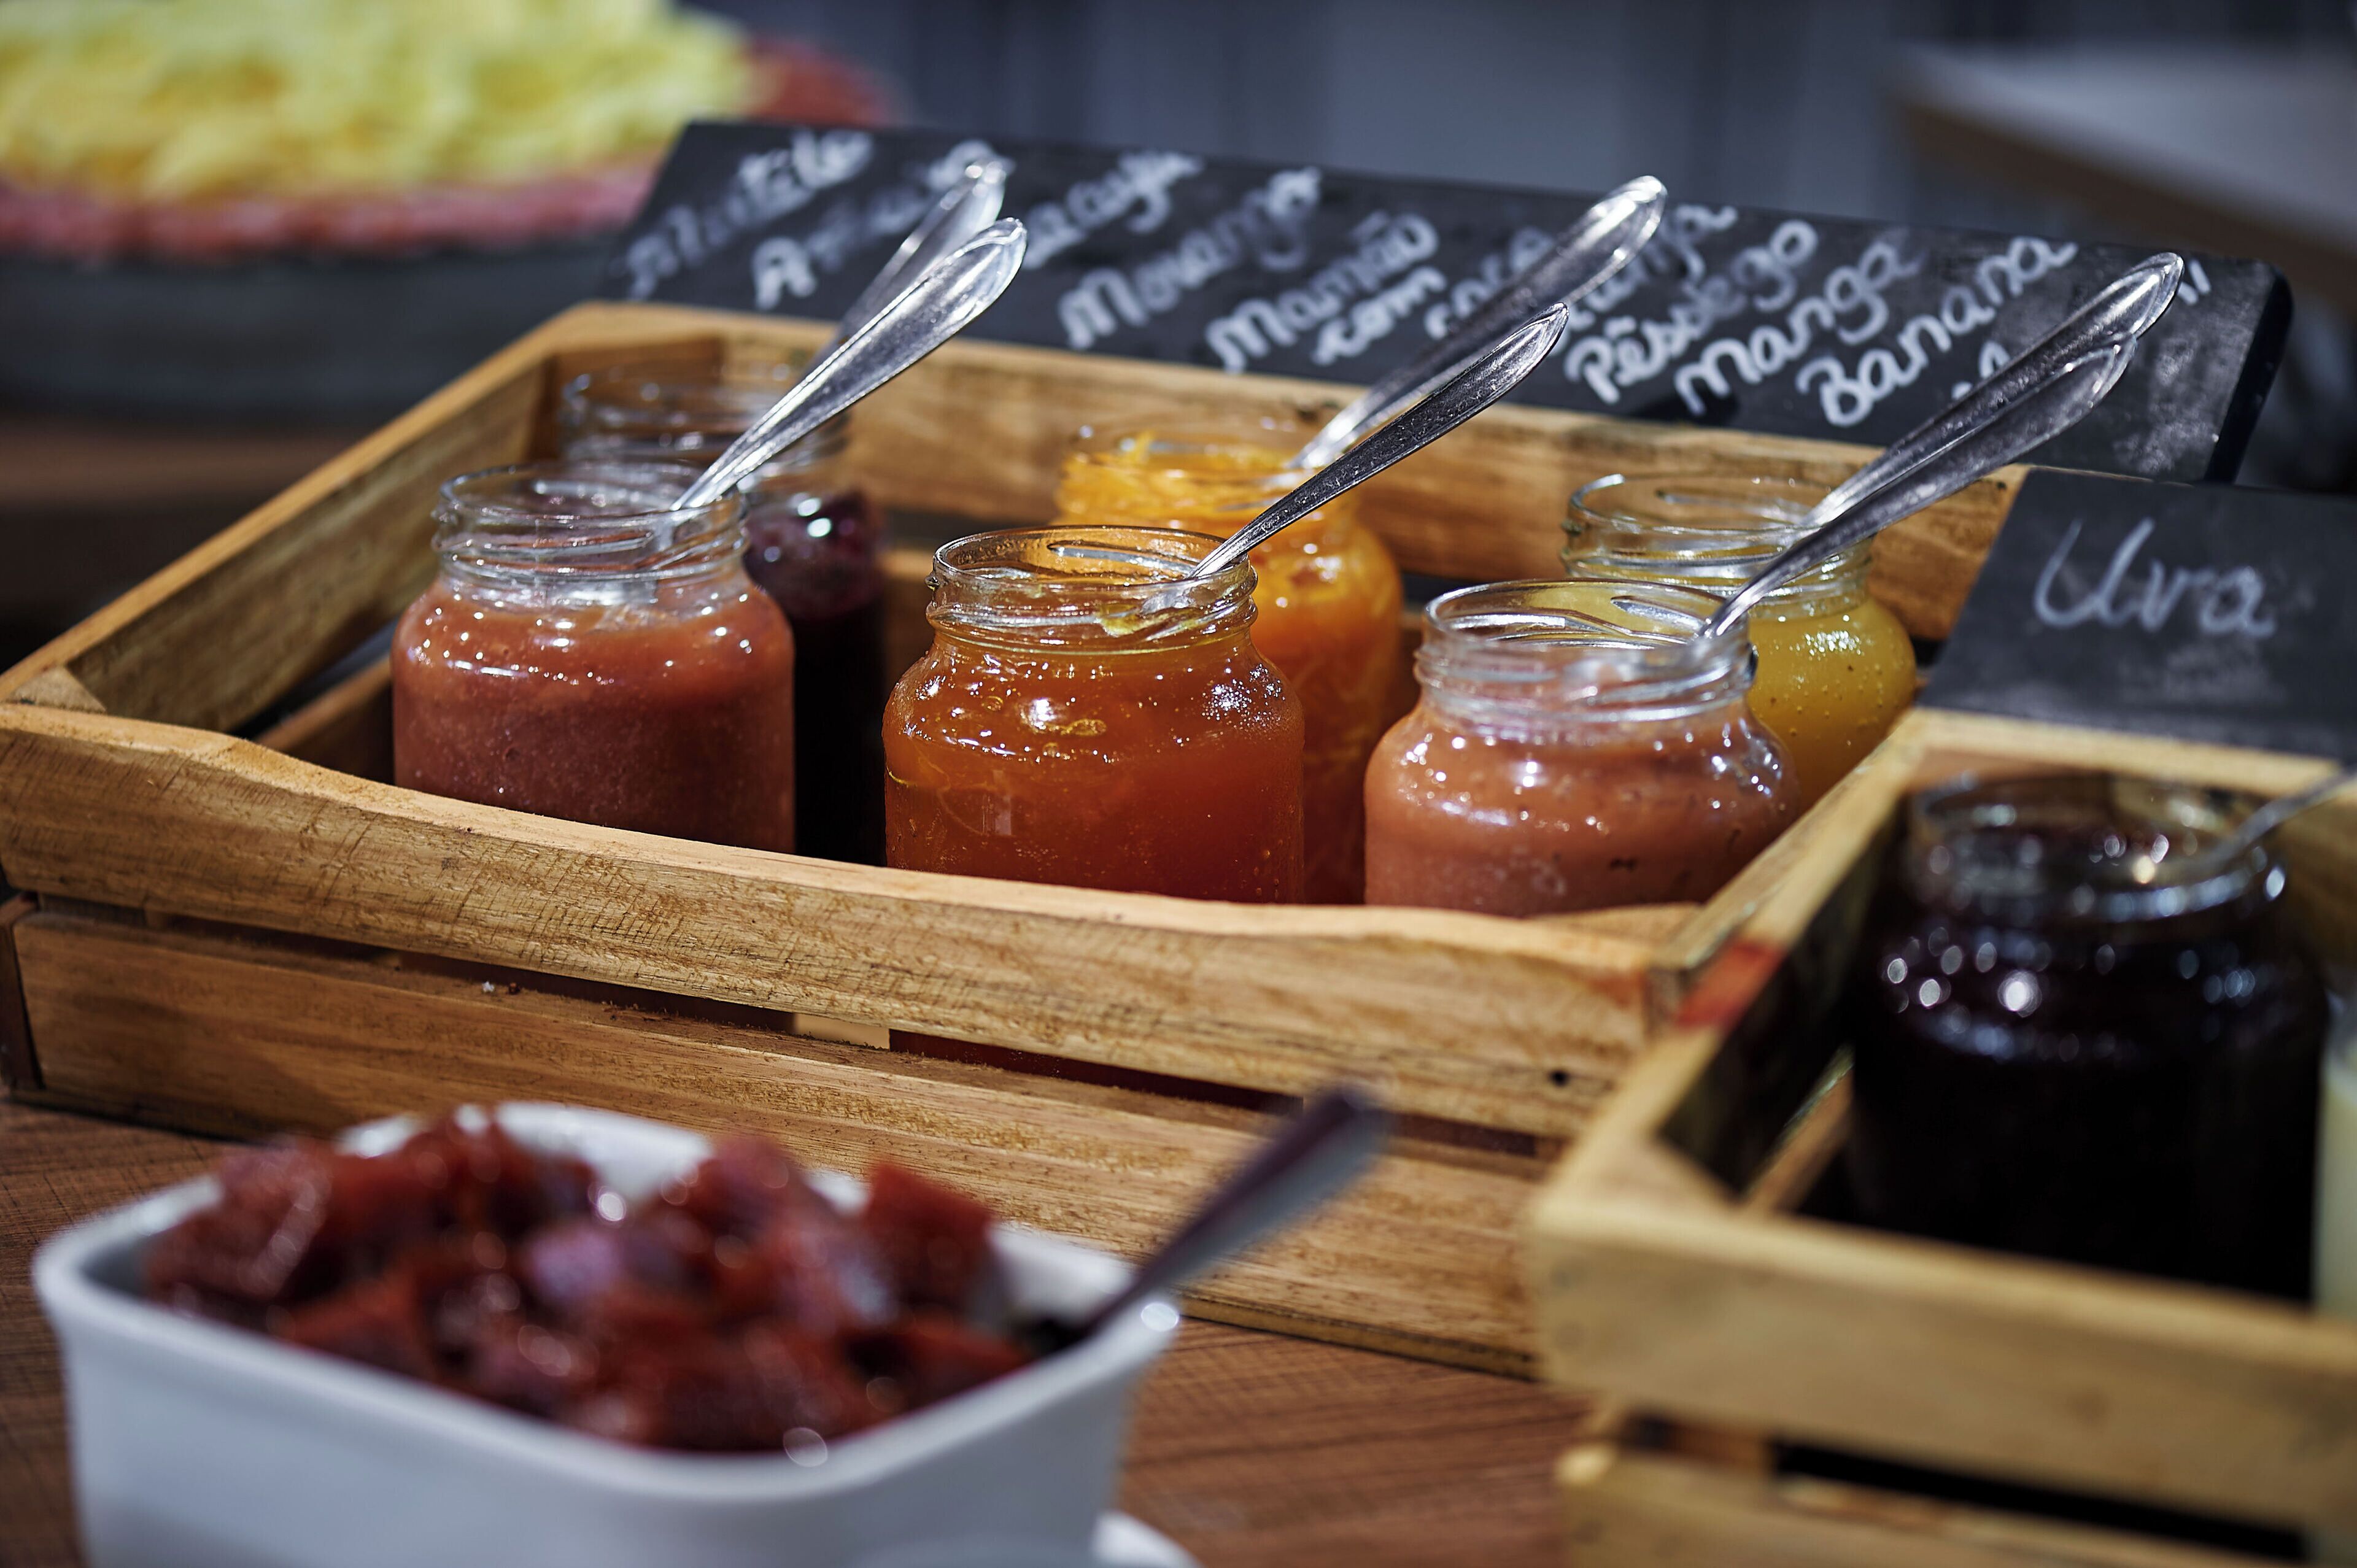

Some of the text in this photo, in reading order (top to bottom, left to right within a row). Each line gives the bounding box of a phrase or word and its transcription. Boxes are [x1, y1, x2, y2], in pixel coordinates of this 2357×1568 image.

[1057, 167, 1321, 350] Morango
[1205, 210, 1438, 373] Mamão
[1797, 236, 2078, 427] Banana
[2033, 516, 2278, 639] Uva
